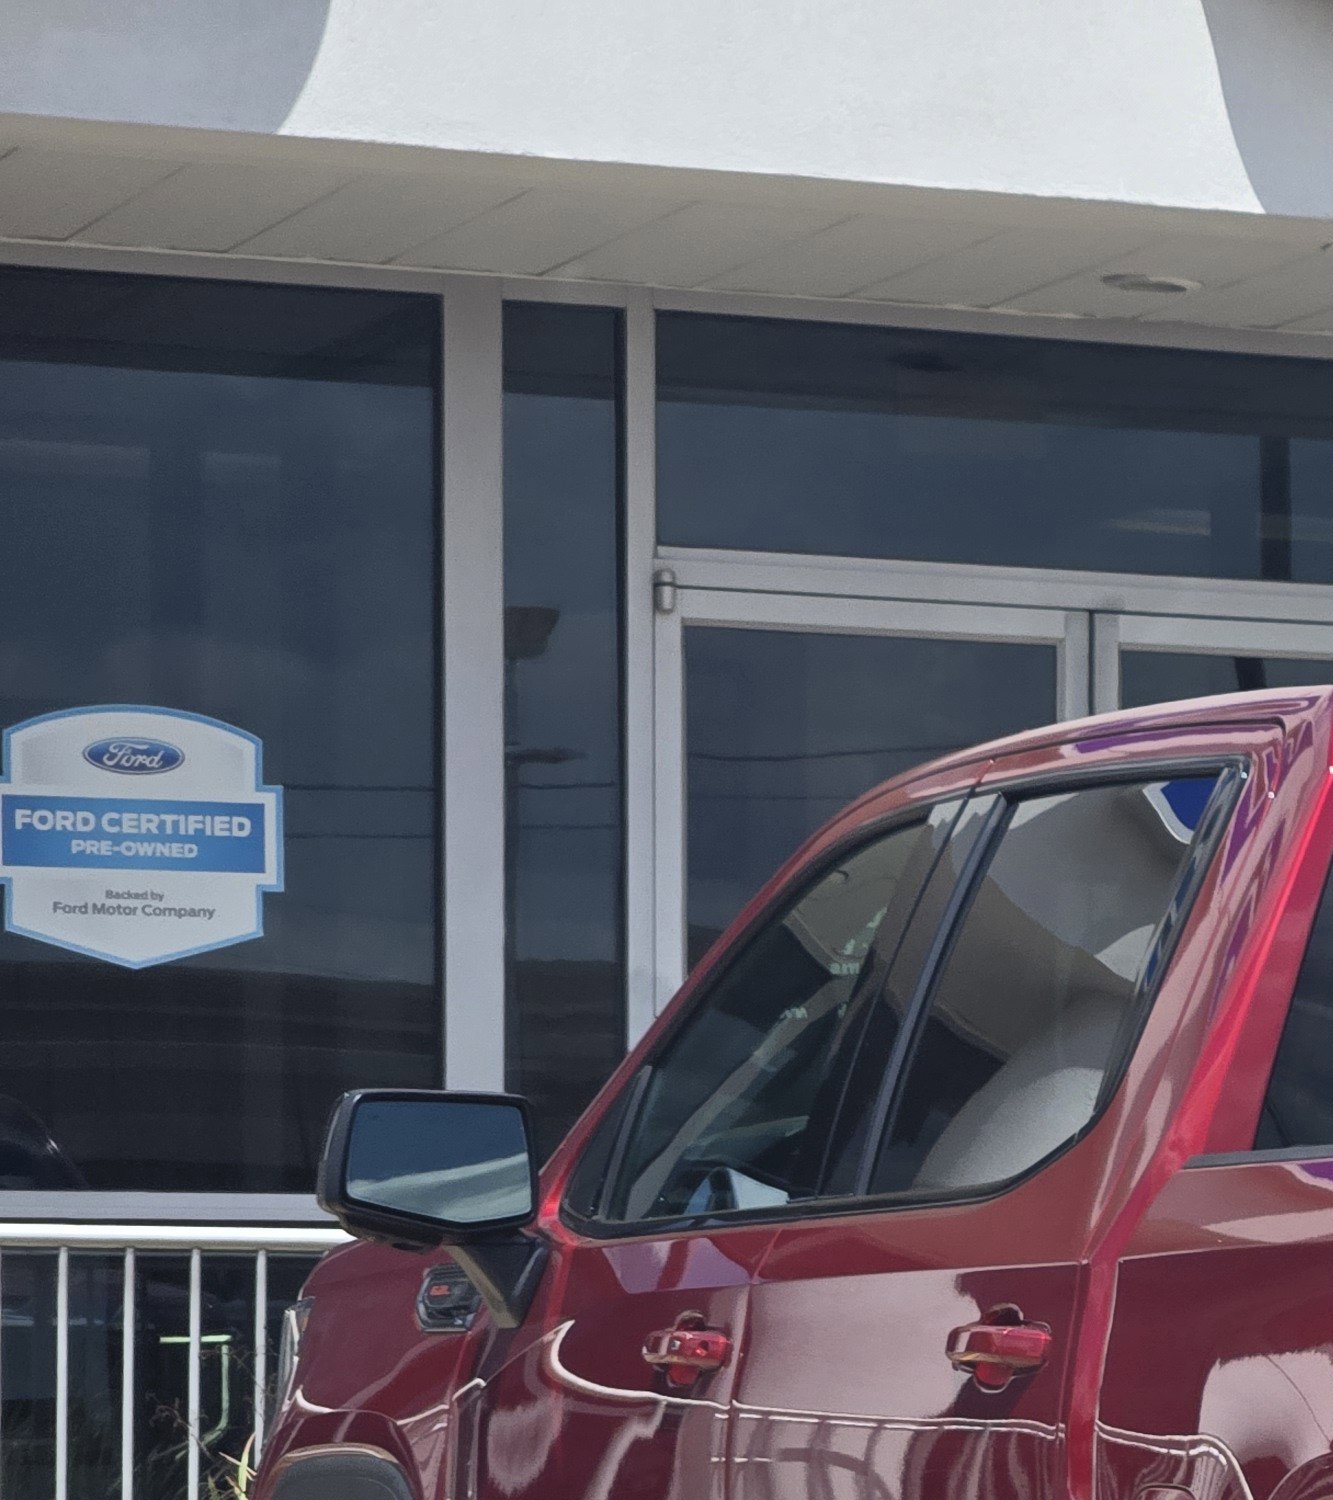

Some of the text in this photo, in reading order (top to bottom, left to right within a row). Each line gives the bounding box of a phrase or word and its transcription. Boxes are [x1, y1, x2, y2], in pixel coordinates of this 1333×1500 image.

[14, 808, 252, 838] FORD CERTIFIED
[71, 838, 198, 859] PRE-OWNED
[105, 889, 164, 902] Backed by
[52, 901, 216, 920] Ford Motor Company
